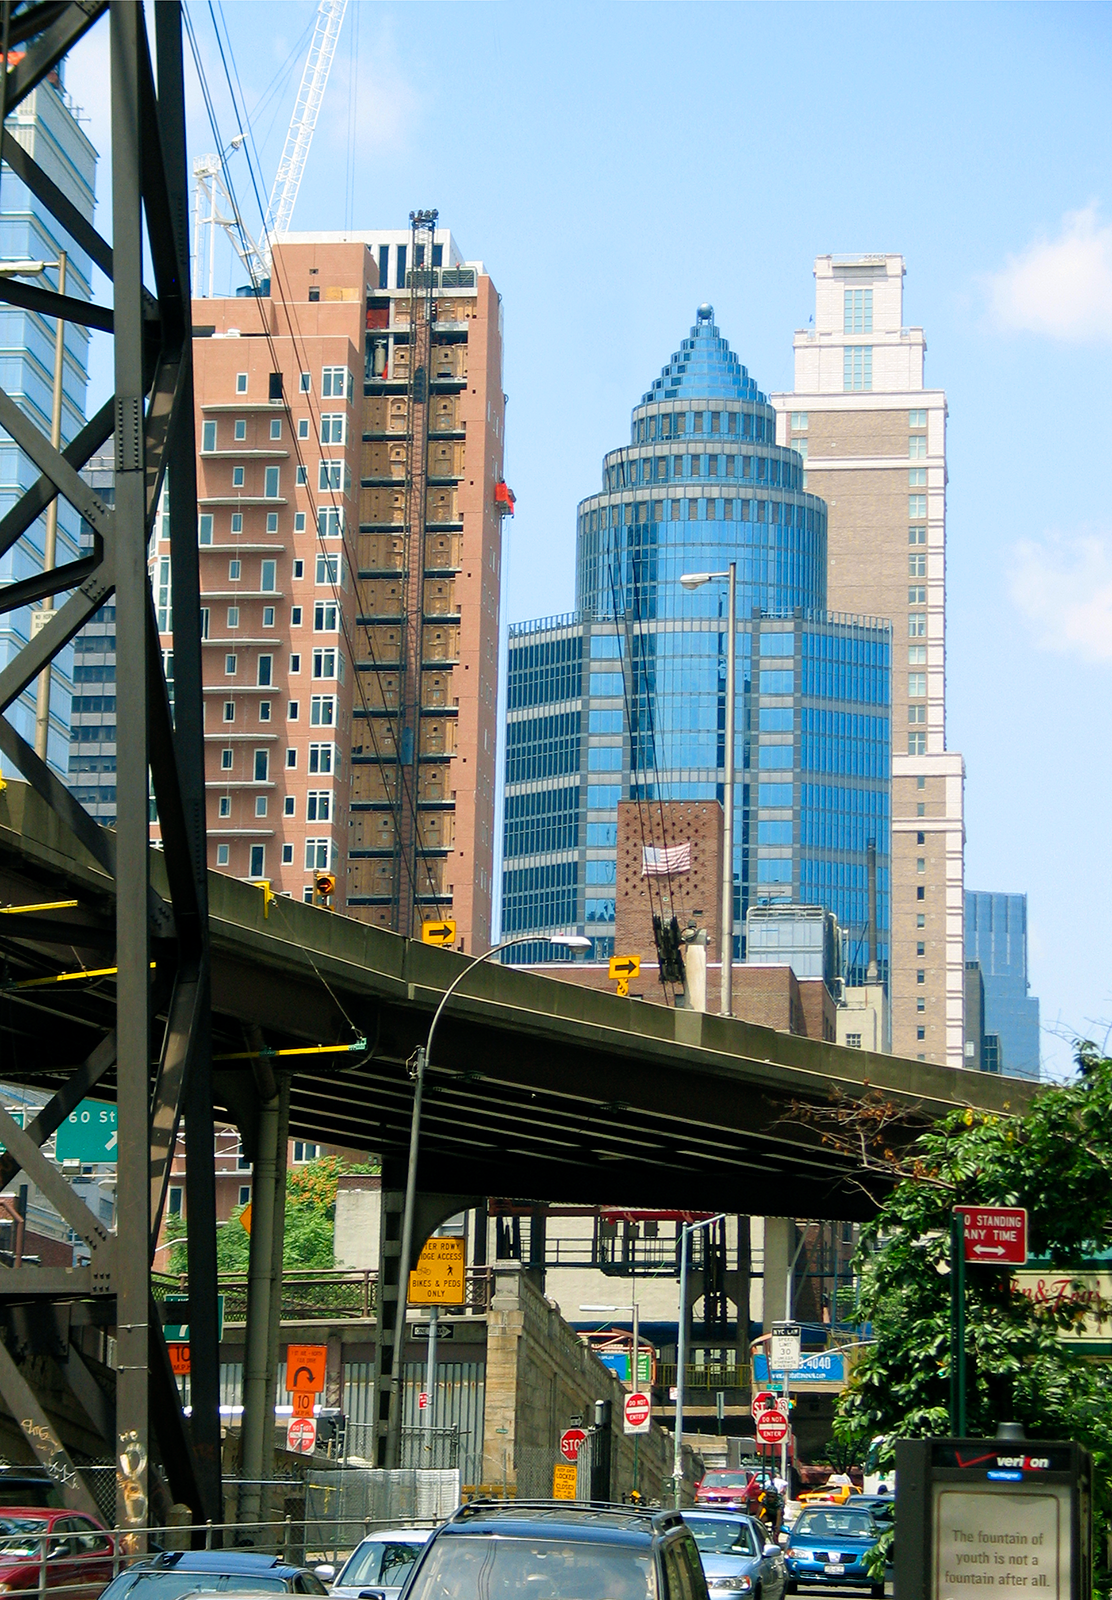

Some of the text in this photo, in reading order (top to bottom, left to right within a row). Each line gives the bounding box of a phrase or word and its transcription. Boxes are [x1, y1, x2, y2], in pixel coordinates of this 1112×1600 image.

[68, 1110, 116, 1123] 60 St
[976, 1214, 1022, 1228] STANDING
[963, 1228, 1018, 1242] ANY TIME
[440, 1242, 460, 1250] RDWY
[420, 1252, 462, 1261] IDGE ACCESS
[412, 1280, 432, 1288] BIKES
[443, 1280, 462, 1288] PEDS
[427, 1290, 446, 1298] ONLY
[780, 1348, 791, 1356] 30
[297, 1395, 310, 1409] 10
[763, 1430, 782, 1438] ENTER
[562, 1438, 582, 1452] STO
[996, 1454, 1049, 1470] verizon
[952, 1529, 1044, 1546] The fountain of
[955, 1551, 1039, 1566] youth is not a
[945, 1571, 1051, 1588] fountain after all.
